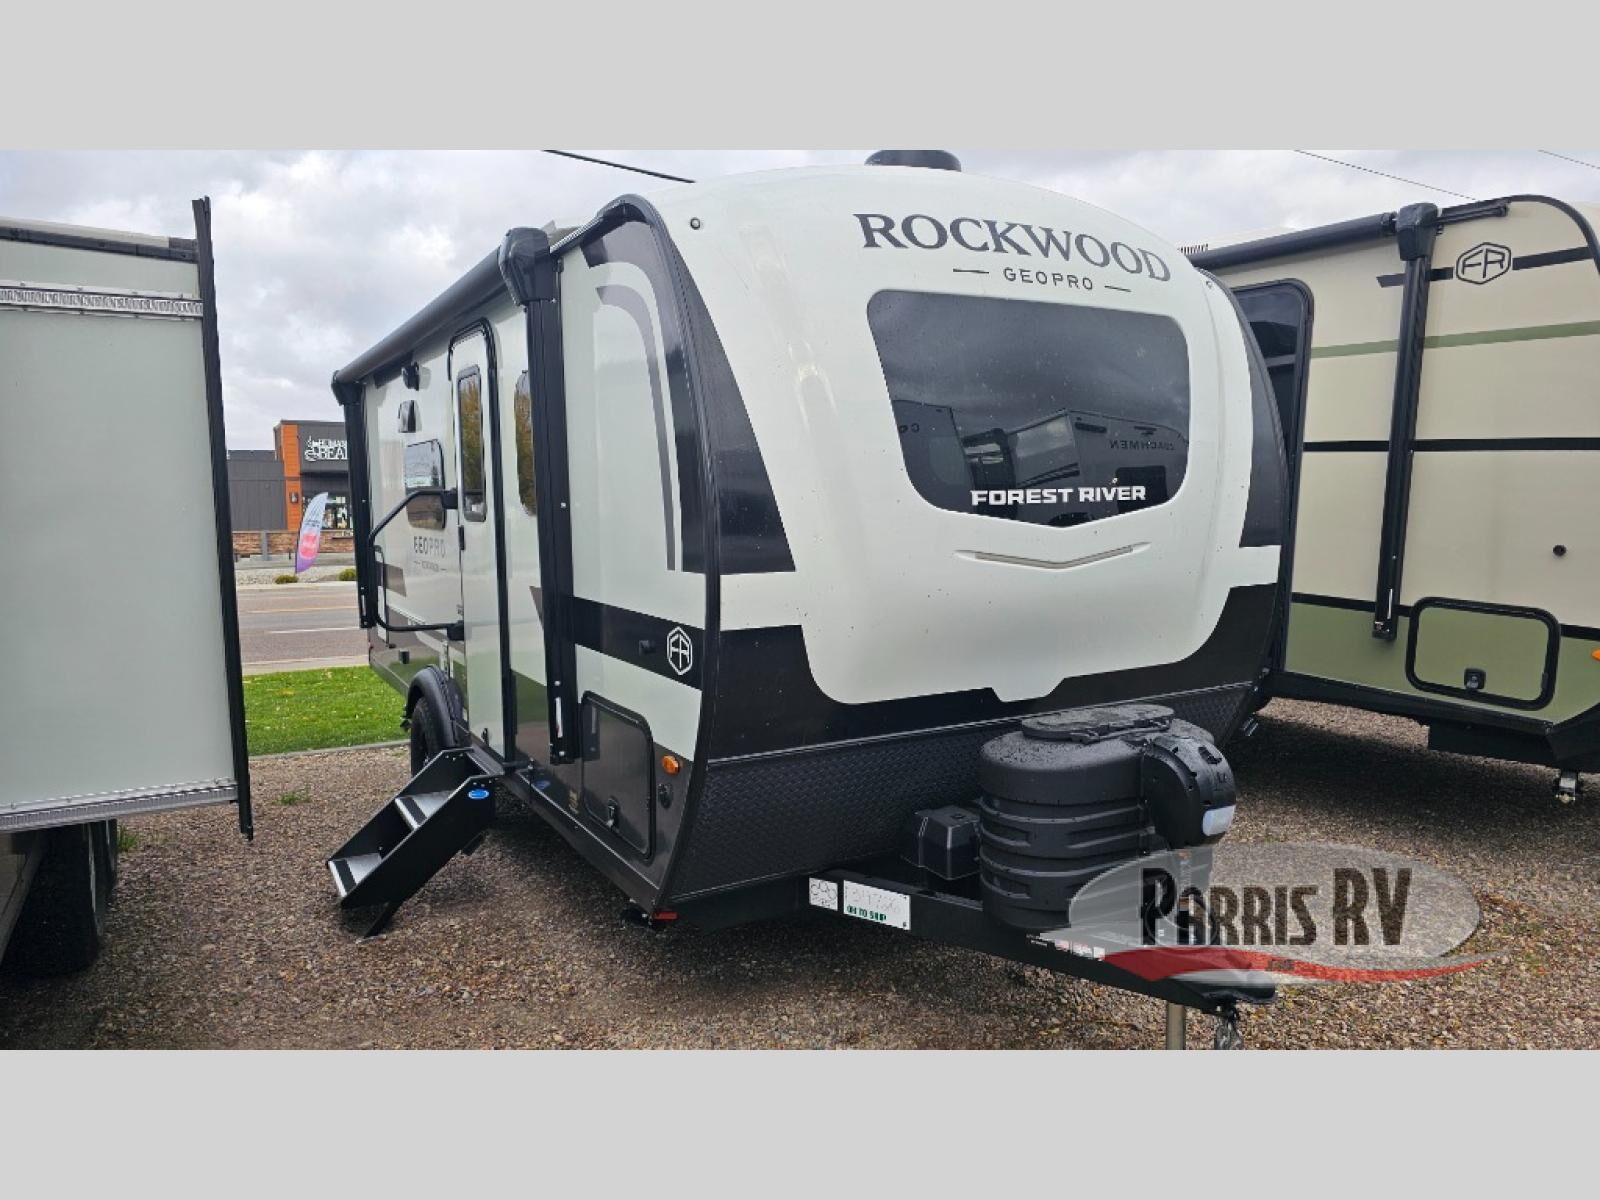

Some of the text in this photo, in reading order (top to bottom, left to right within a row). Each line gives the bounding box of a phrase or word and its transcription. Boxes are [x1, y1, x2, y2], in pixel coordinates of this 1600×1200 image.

[853, 213, 1171, 282] ROCKWOOD
[1003, 266, 1093, 290] GEOPRO
[970, 485, 1146, 506] FOREST RIVER
